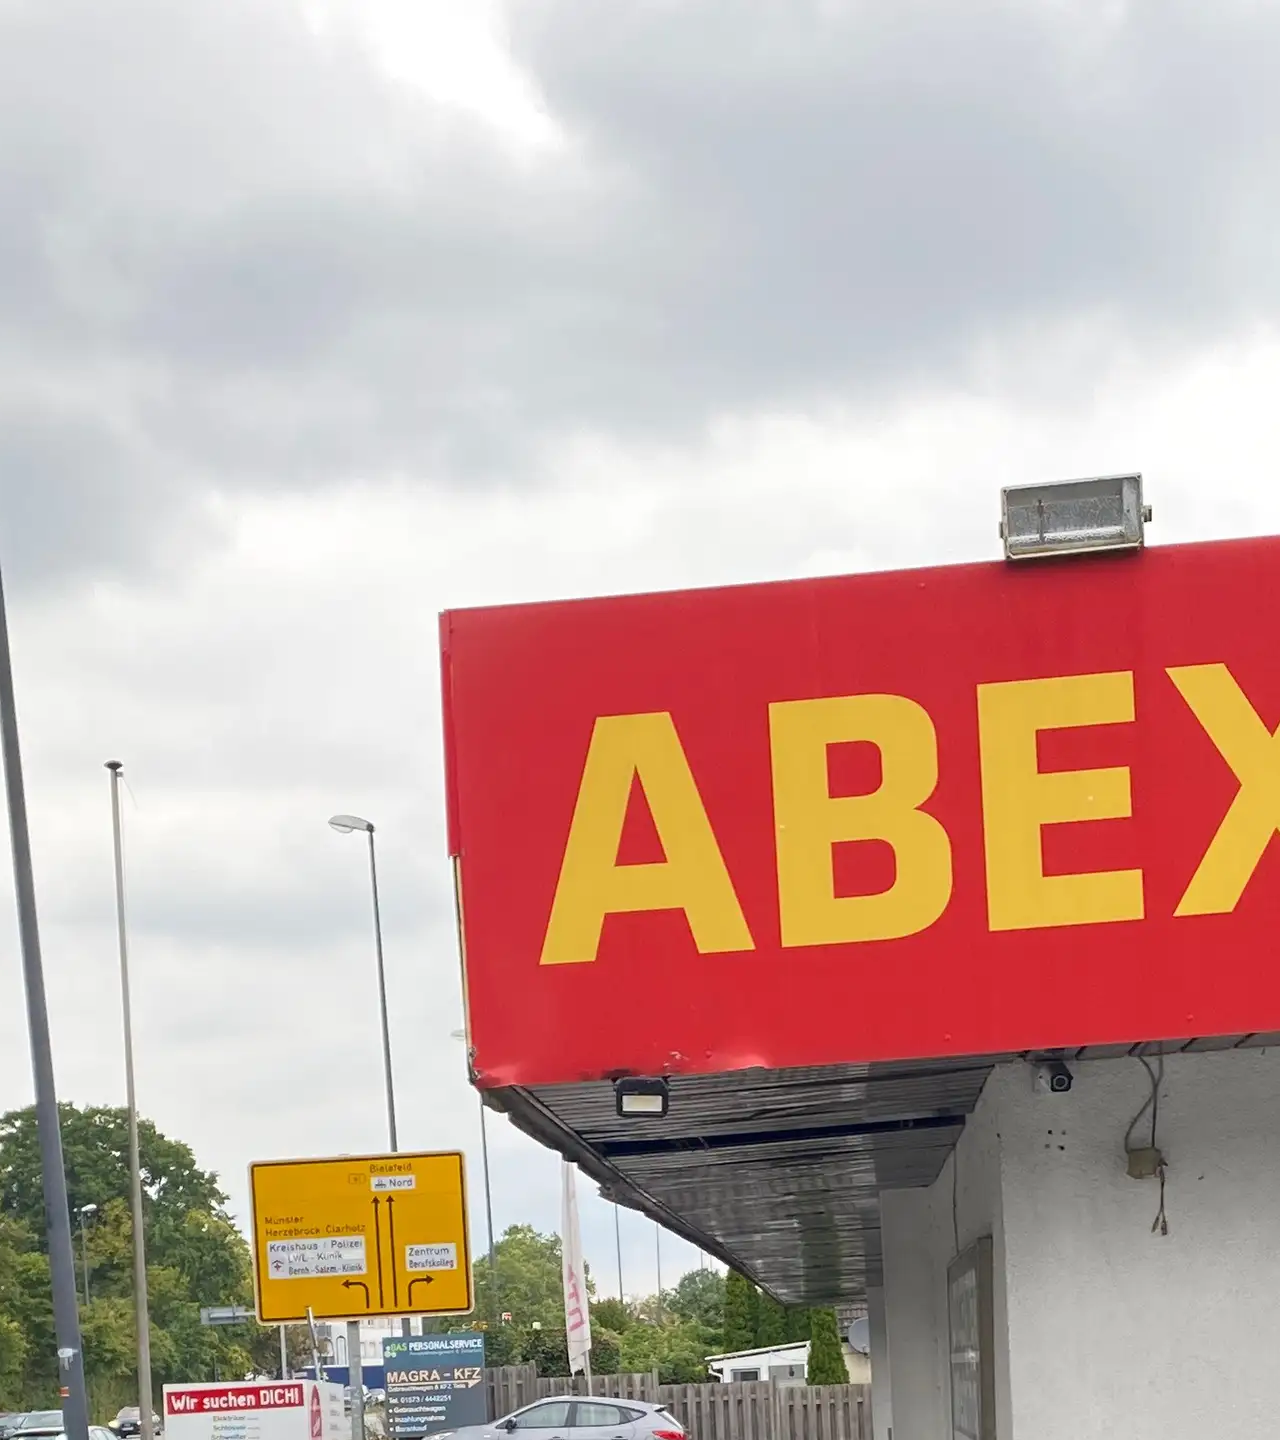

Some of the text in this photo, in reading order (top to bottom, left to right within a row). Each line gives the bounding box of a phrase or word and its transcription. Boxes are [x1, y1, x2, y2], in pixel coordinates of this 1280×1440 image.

[369, 1163, 412, 1173] Bielefeld
[389, 1178, 413, 1188] Nord
[269, 1241, 318, 1253] Kreishaus
[330, 1239, 363, 1249] Polizei
[408, 1247, 450, 1257] Zentrum
[408, 1259, 455, 1268] Berufskolleg
[409, 1338, 483, 1351] PERSONALSERVICE
[387, 1369, 441, 1383] MAGRA
[453, 1367, 482, 1380] KFZ
[171, 1387, 300, 1411] Wir suchen DICH!
